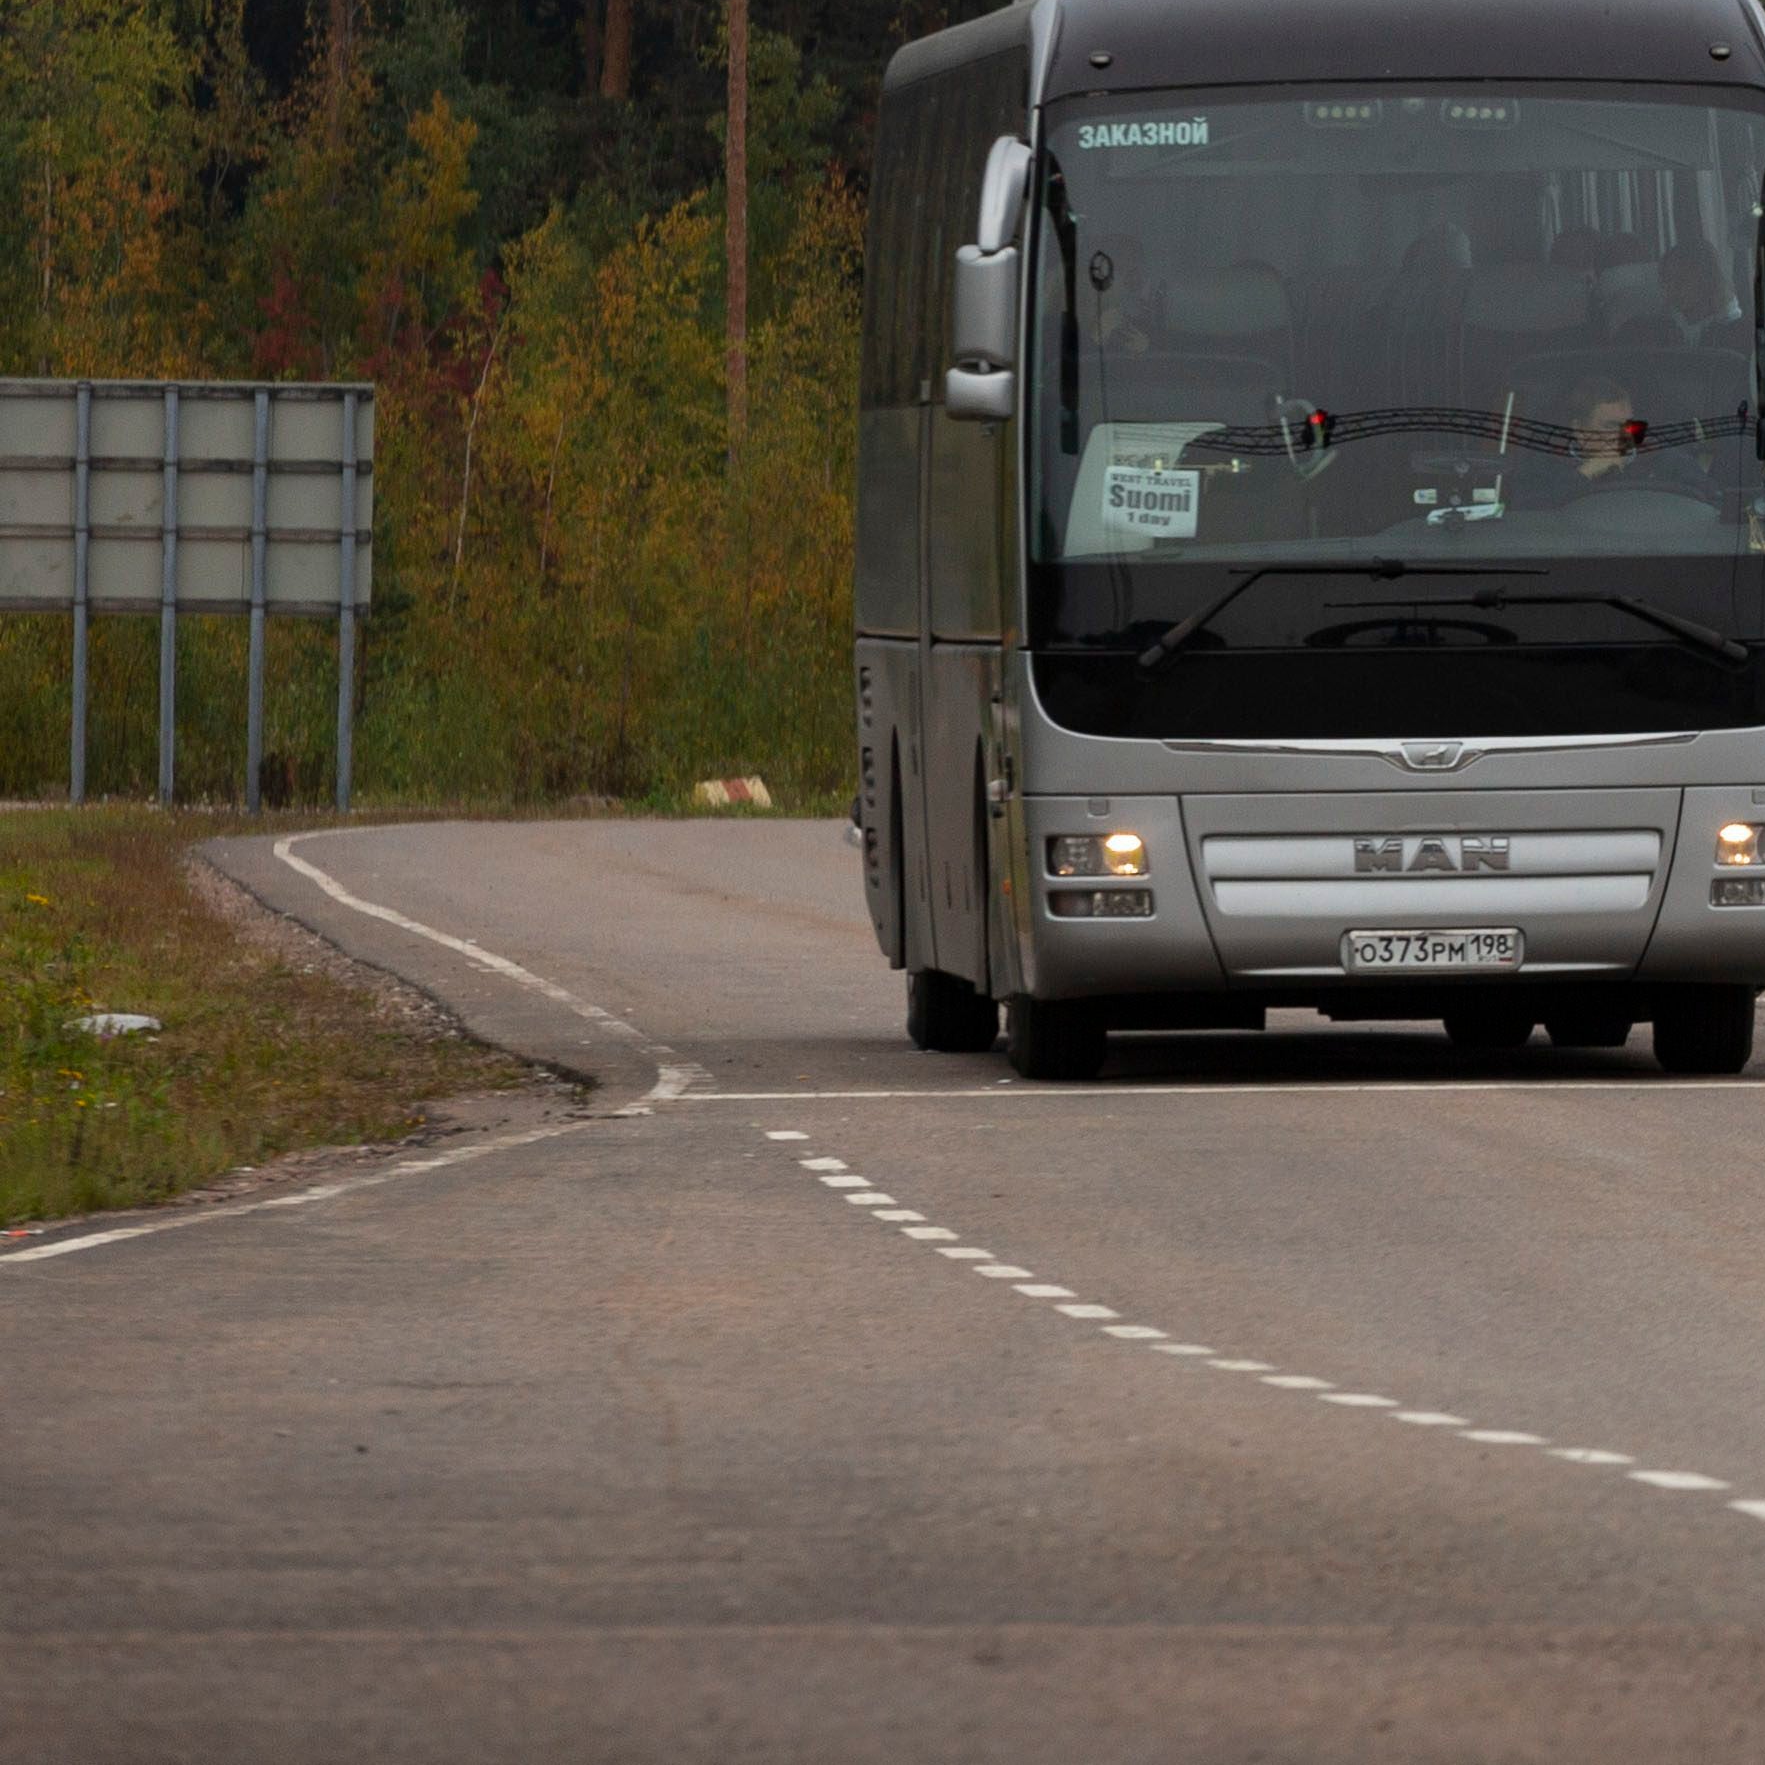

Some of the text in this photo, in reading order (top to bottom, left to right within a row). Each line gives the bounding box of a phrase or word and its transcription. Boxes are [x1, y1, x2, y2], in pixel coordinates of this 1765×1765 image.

[1078, 116, 1208, 149] ЗАКАЗНОЙ
[1109, 483, 1191, 512] Suomi
[1354, 837, 1510, 873] MAN
[1470, 934, 1509, 954] 198
